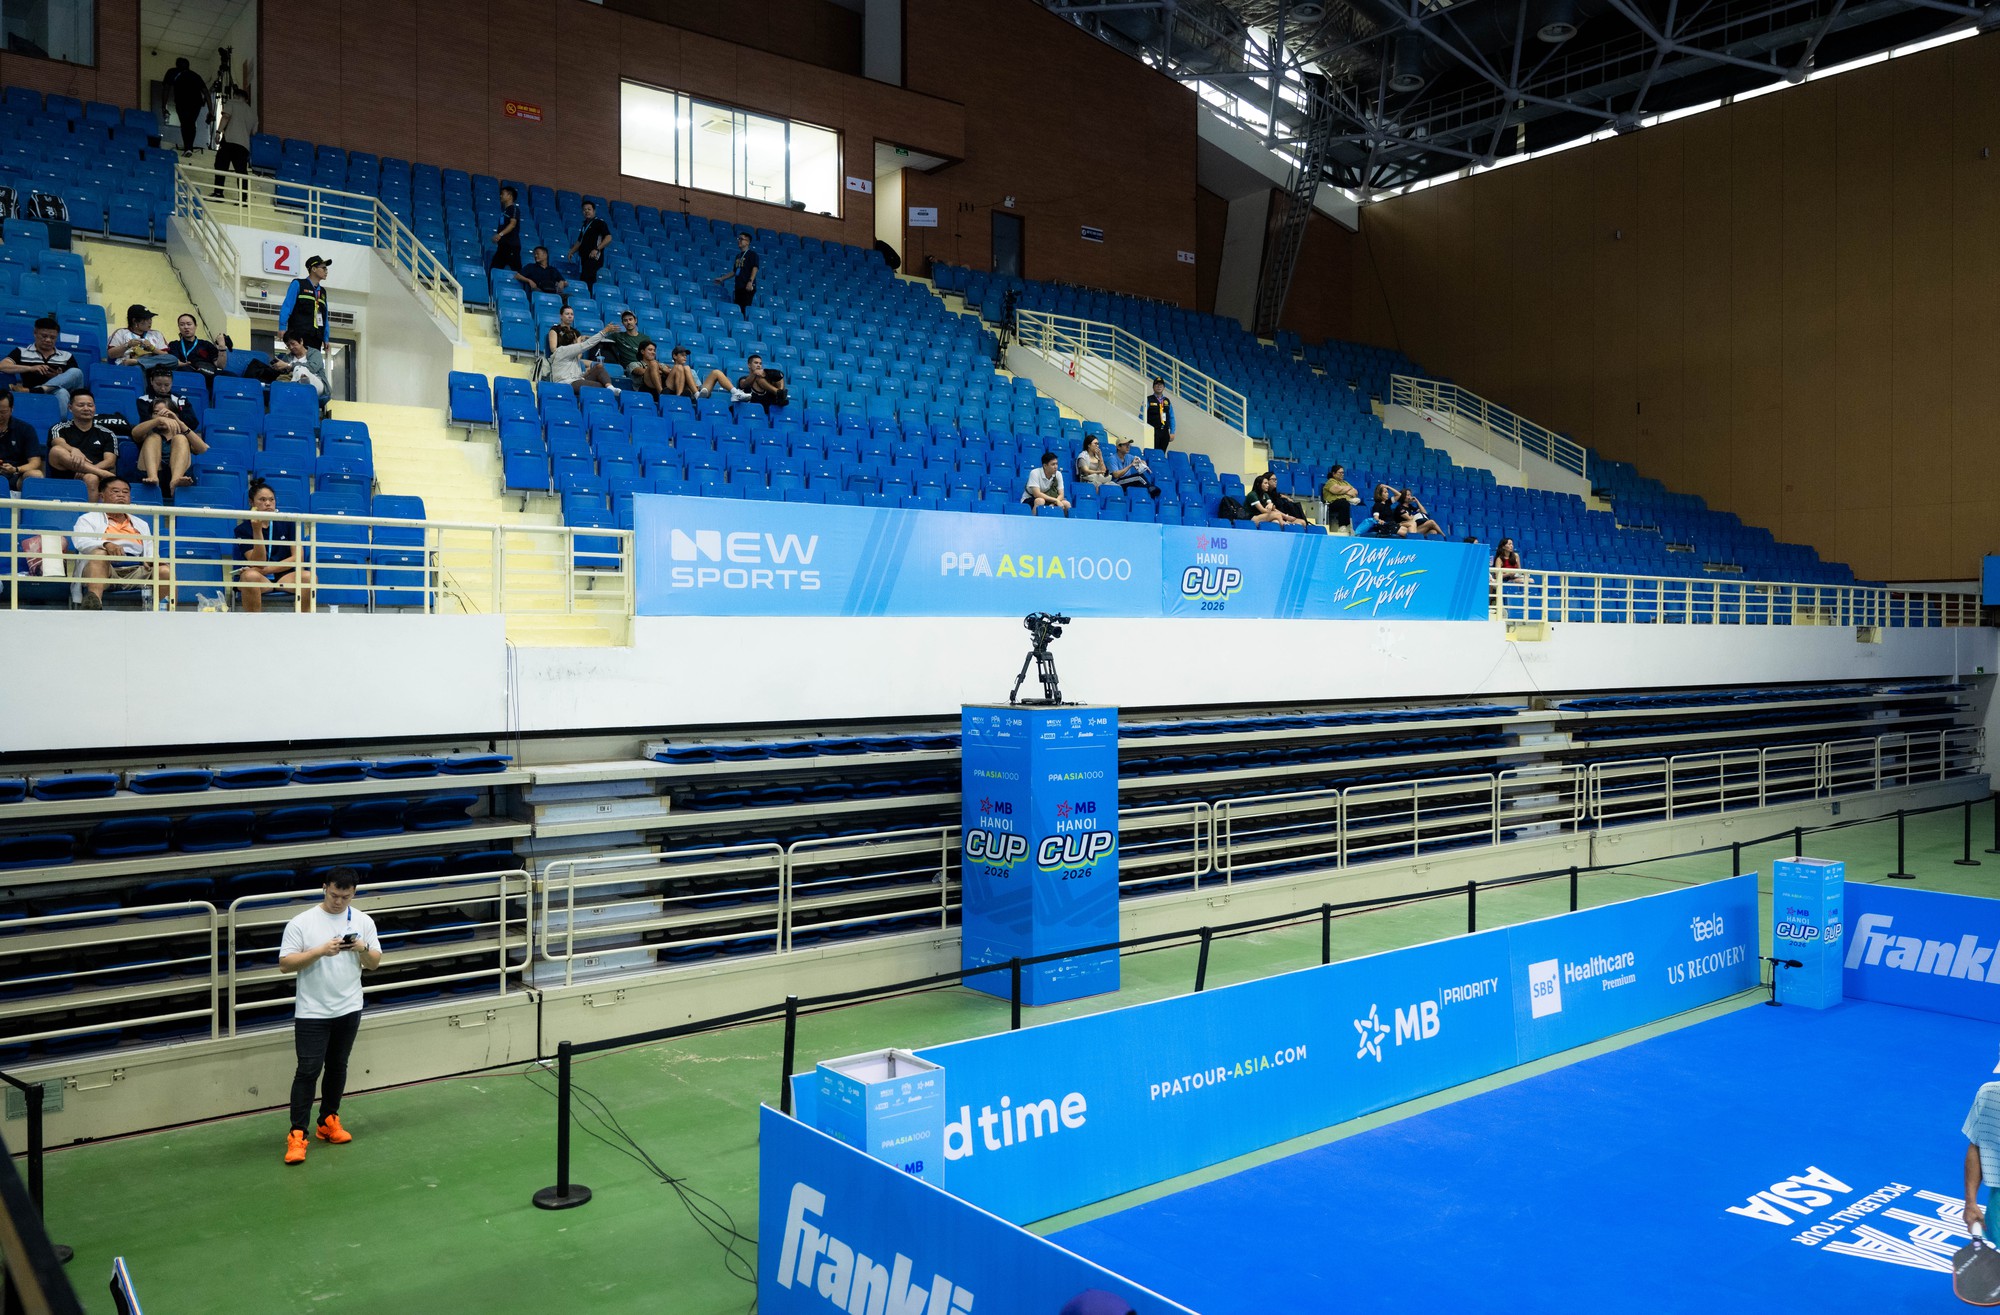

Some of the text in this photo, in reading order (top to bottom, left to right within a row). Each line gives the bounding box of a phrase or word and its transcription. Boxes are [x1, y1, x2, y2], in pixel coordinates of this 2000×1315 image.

[274, 245, 290, 271] 2
[671, 528, 819, 564] NEW
[1211, 537, 1228, 549] MB
[1196, 553, 1229, 566] HANOI
[1340, 543, 1417, 574] Play where
[671, 567, 821, 590] SPORTS
[1181, 566, 1243, 599] CUP
[1333, 568, 1398, 603] the Pros
[1201, 602, 1225, 611] 2026
[1372, 580, 1420, 617] play
[994, 801, 1013, 815] MB
[1074, 801, 1096, 814] MB
[980, 816, 1013, 832] HANOI
[1056, 817, 1097, 833] HANOI
[965, 828, 1029, 865] CUP
[1037, 830, 1115, 868] CUP
[984, 865, 1010, 879] 2026
[1061, 867, 1092, 880] 2026
[1776, 922, 1820, 942] CUP
[1786, 916, 1810, 925] HANOI
[1824, 923, 1842, 943] CUP
[1564, 951, 1635, 985] Healthcare
[1667, 944, 1746, 985] US RECOVERY
[1602, 973, 1636, 991] Premium
[1395, 977, 1498, 1046] MB PRIORITY
[1150, 1044, 1307, 1101] PPATOUR-ASIA.COM
[905, 1160, 924, 1174] MB
[1725, 1165, 1854, 1226] ASIA
[1791, 1182, 1912, 1246] PICKLEBALL TOUR
